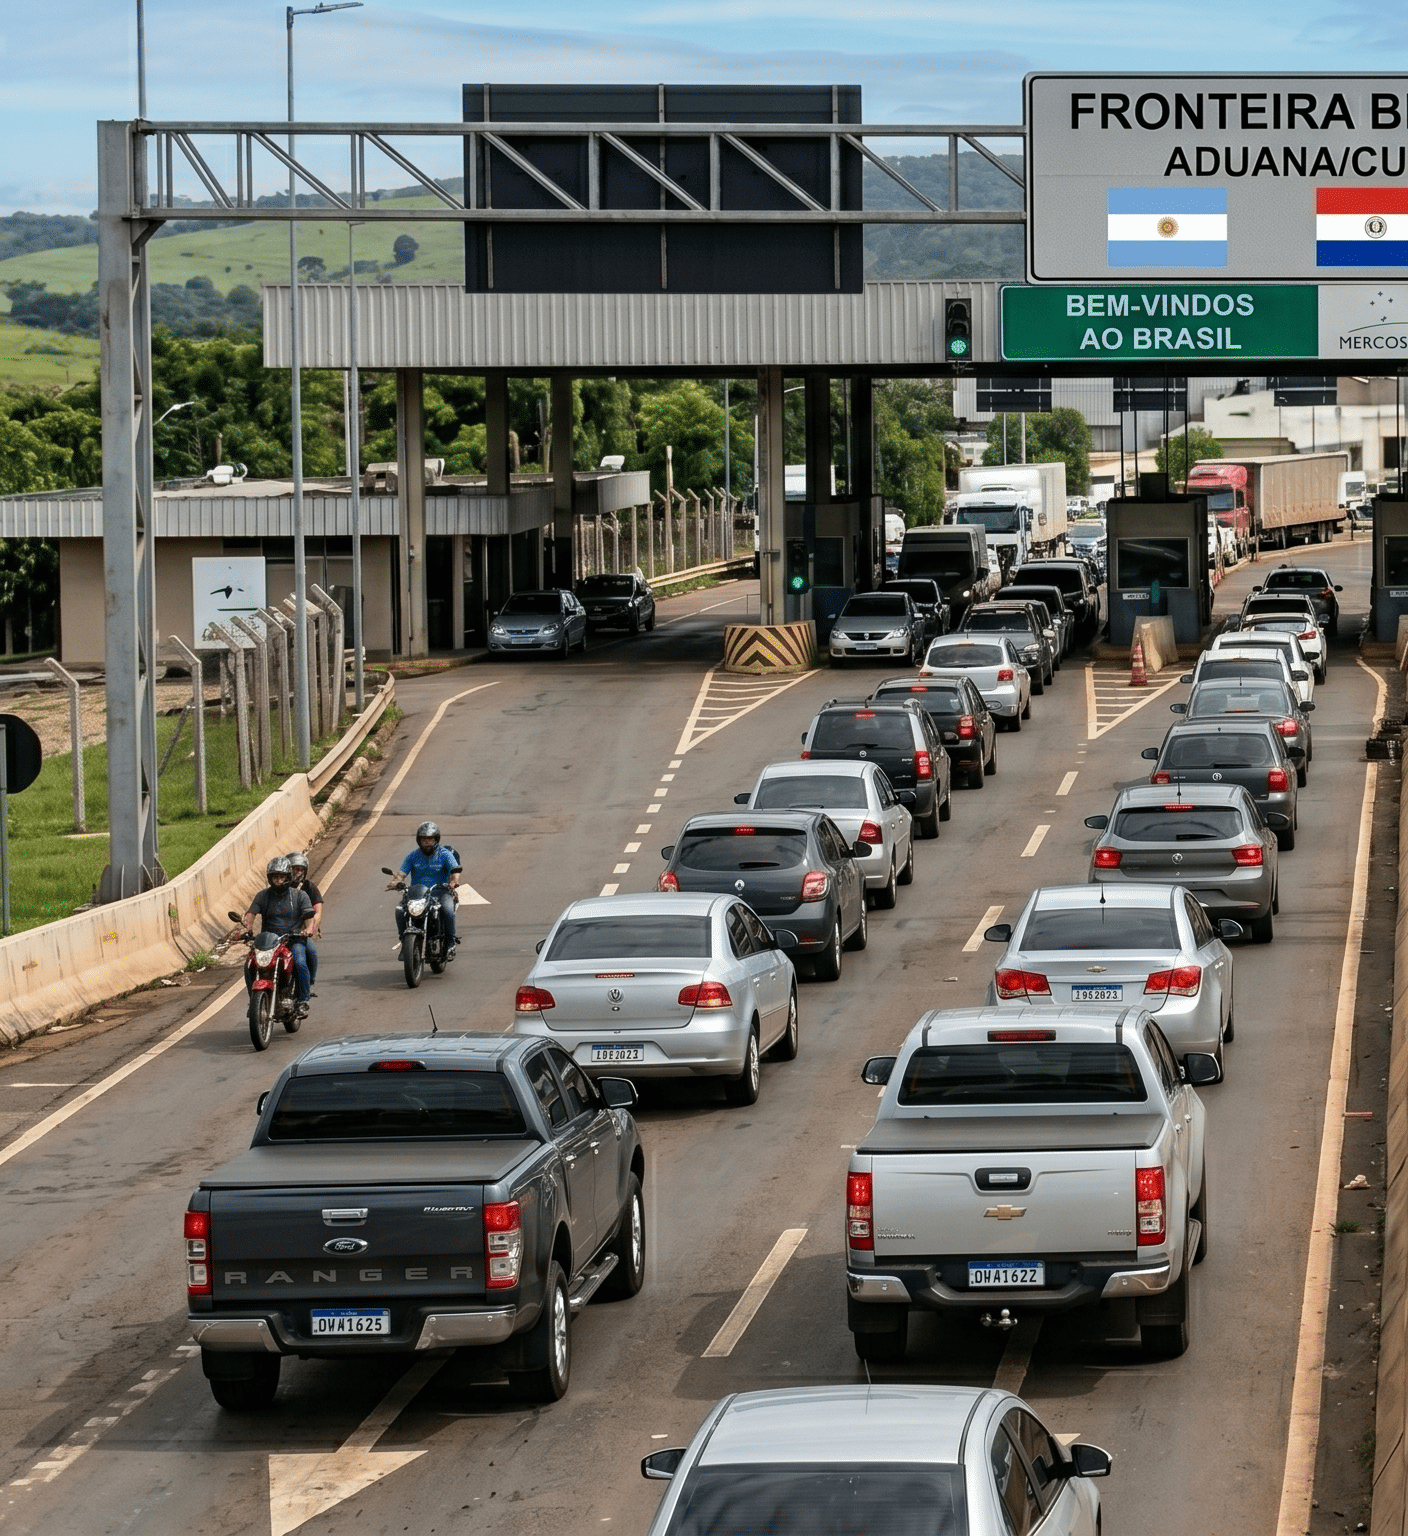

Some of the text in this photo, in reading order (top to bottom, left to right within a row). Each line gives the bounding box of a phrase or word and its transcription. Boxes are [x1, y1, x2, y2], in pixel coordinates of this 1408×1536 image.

[1071, 92, 1356, 131] FRONTEIRA
[1067, 293, 1254, 316] BEM-VINDOS
[1079, 327, 1242, 350] AO BRASIL
[224, 1266, 474, 1285] RANGER
